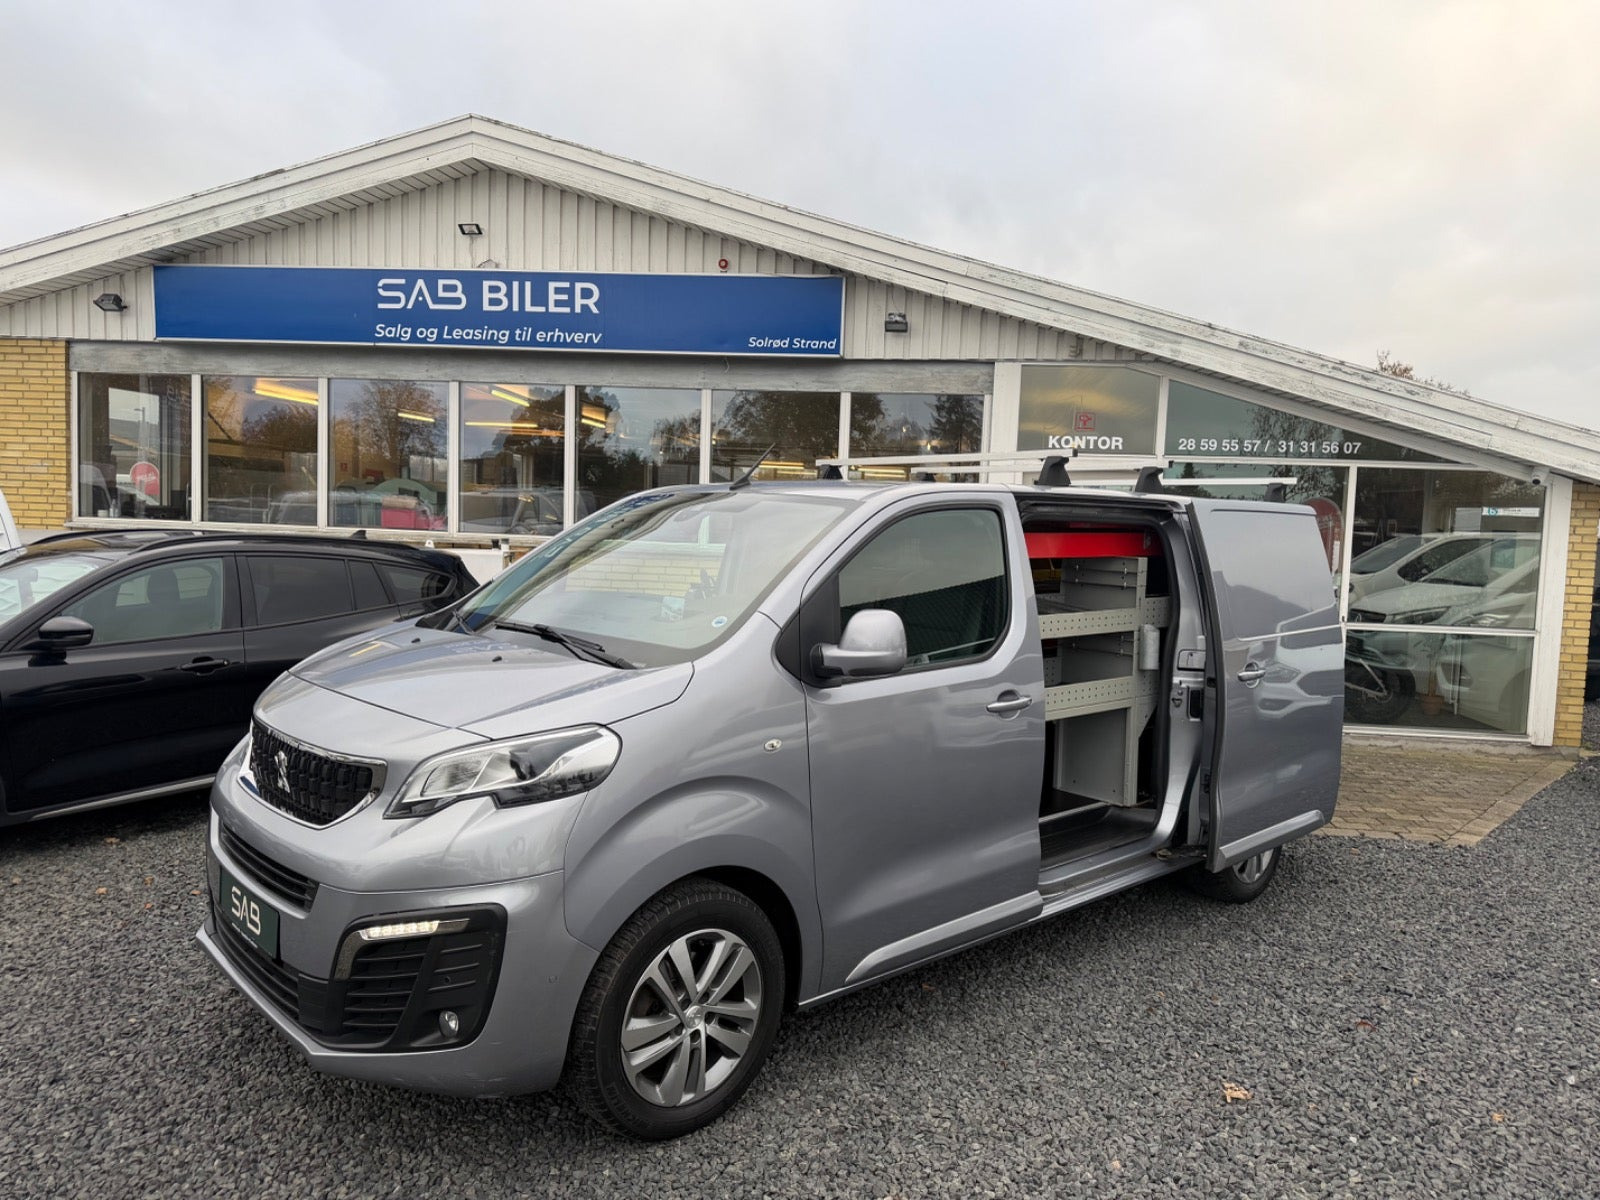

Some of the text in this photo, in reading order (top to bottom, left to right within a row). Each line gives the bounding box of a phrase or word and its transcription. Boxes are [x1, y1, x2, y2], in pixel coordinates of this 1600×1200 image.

[377, 278, 600, 314] SAB BILER
[374, 323, 602, 344] Salg og Leasing til erhverv
[748, 336, 837, 349] Solrød Strand
[1048, 435, 1123, 450] KONTOR
[1178, 438, 1196, 450] 28
[1199, 438, 1217, 451] 59
[1221, 439, 1239, 451] 55
[1278, 440, 1294, 453] 31
[1300, 441, 1316, 453] 31
[1322, 441, 1339, 454] 56
[1343, 441, 1362, 454] 07
[231, 885, 261, 936] SAB
